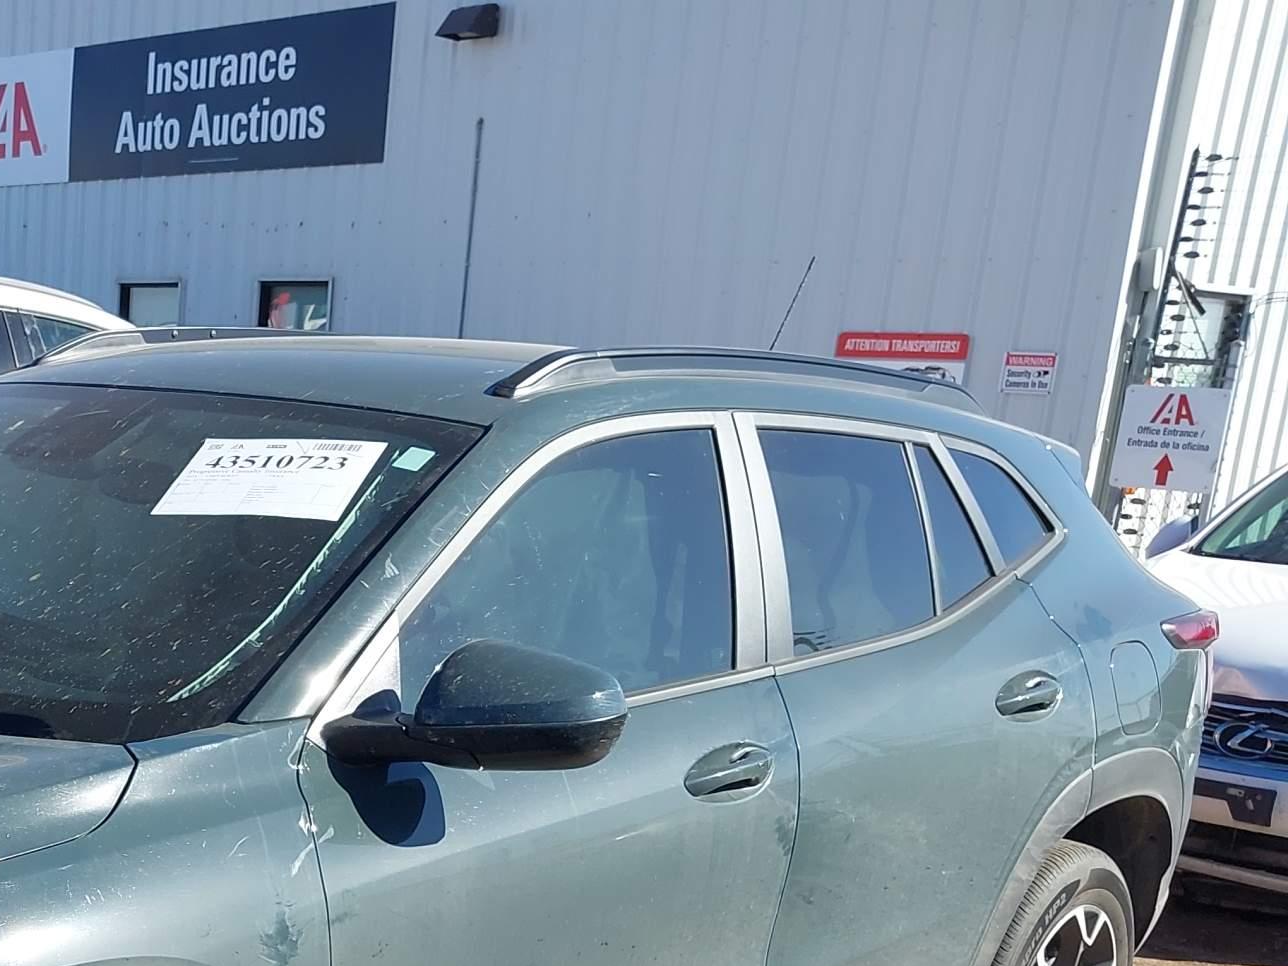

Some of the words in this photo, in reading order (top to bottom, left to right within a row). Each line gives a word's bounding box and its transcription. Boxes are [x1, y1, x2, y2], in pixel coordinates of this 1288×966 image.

[147, 46, 297, 95] Insurance
[115, 111, 180, 154] Auto
[188, 97, 326, 149] Auctions
[844, 338, 890, 352] ATTENTION
[891, 339, 961, 353] TRANSPORTERS!
[1008, 357, 1054, 367] WARNING
[1006, 369, 1032, 380] Security
[1004, 379, 1030, 389] Cameras
[1137, 425, 1161, 436] Office
[1162, 427, 1199, 438] Entrance
[1127, 438, 1159, 448] Entrada
[1160, 439, 1171, 449] de
[1172, 440, 1180, 450] la
[1181, 441, 1210, 452] oficina
[205, 455, 349, 471] 43510723
